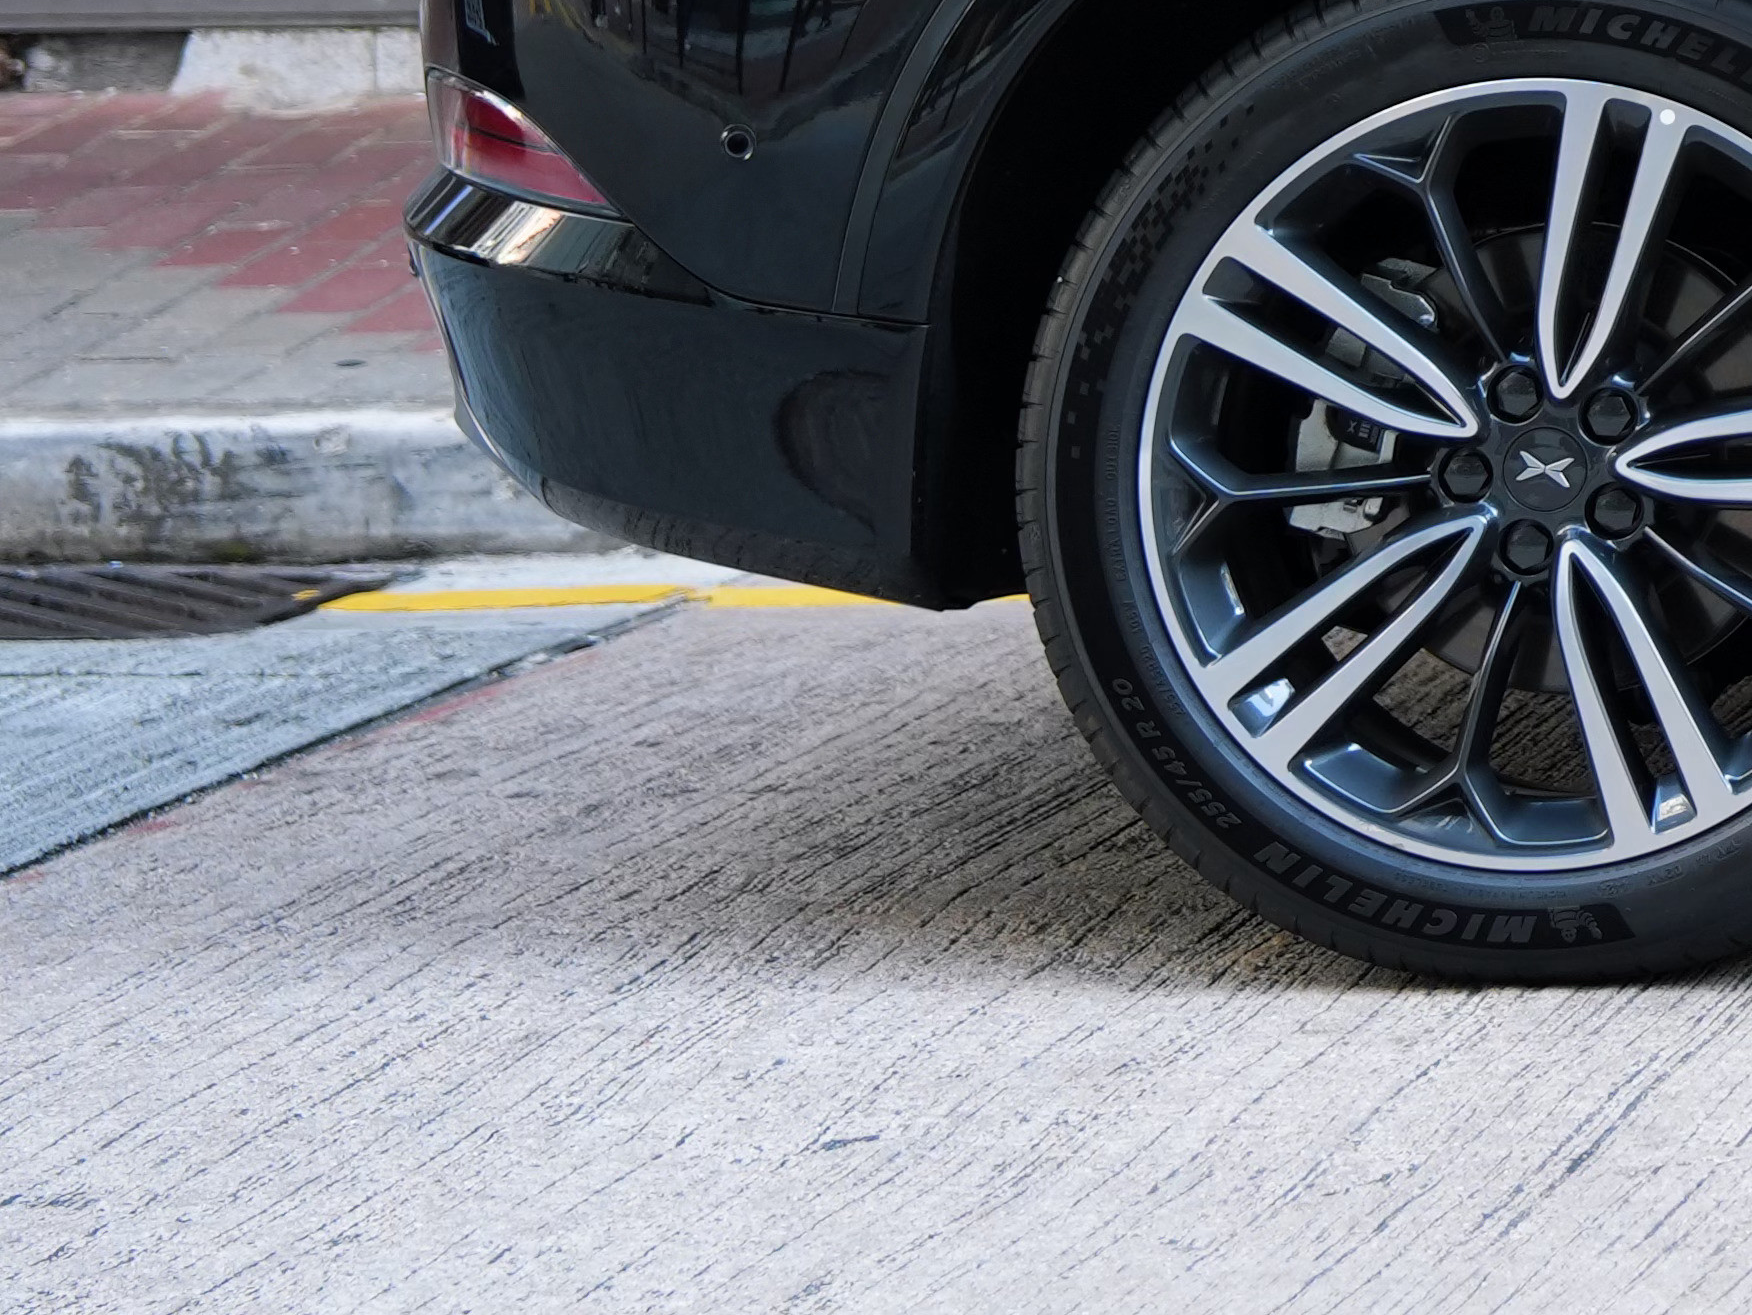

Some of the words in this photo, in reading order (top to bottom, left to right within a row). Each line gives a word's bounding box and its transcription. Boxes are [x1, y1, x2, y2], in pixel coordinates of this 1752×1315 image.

[1109, 671, 1148, 718] 20
[1134, 714, 1163, 743] R
[1150, 738, 1243, 836] 255/45
[1254, 826, 1536, 953] MICHELIN
